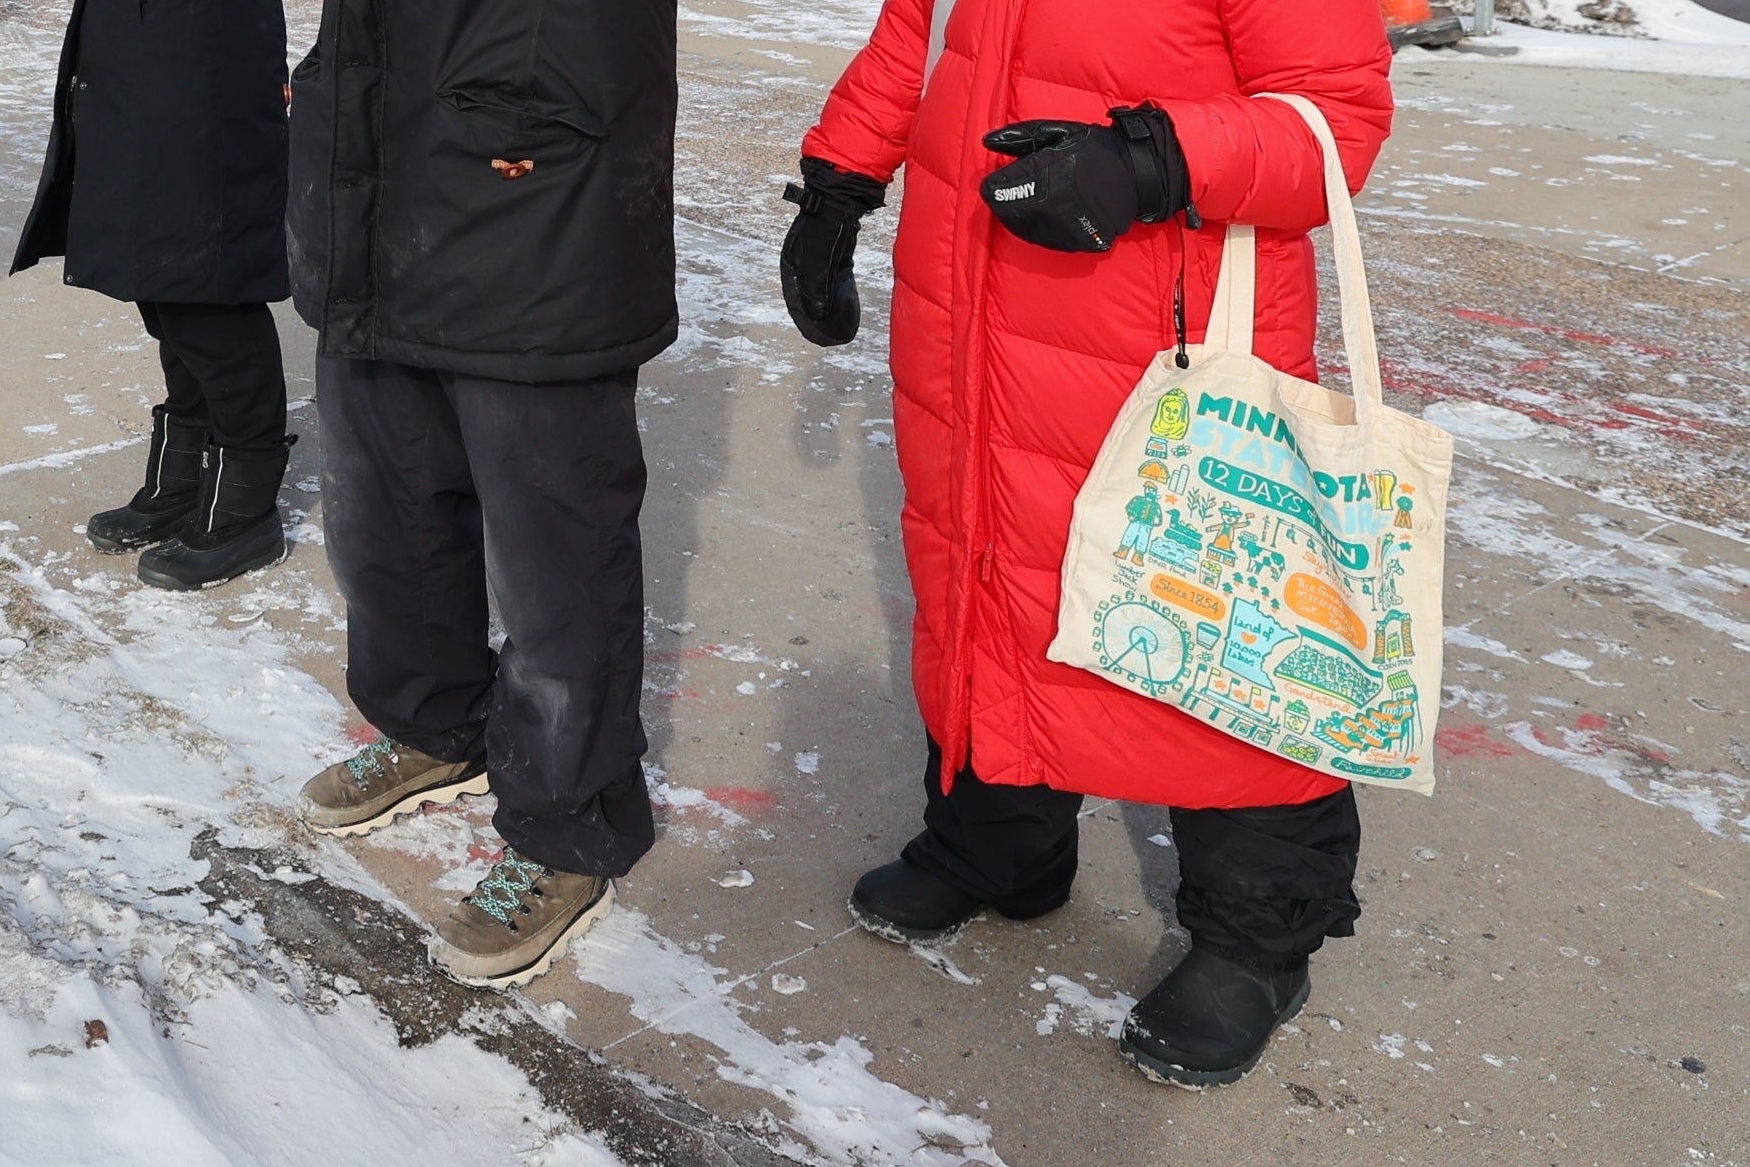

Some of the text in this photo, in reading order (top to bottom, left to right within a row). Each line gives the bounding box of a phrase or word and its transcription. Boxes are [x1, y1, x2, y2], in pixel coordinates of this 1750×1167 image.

[993, 181, 1036, 202] SWANY
[1188, 418, 1309, 486] STATE
[1196, 391, 1372, 504] MINNOTA
[1203, 459, 1231, 488] 12
[1237, 472, 1304, 513] DAYS
[1147, 556, 1168, 570] DNR
[1111, 574, 1138, 592] Show
[1155, 578, 1220, 615] Since 1854
[1335, 760, 1408, 778] Fairchild
